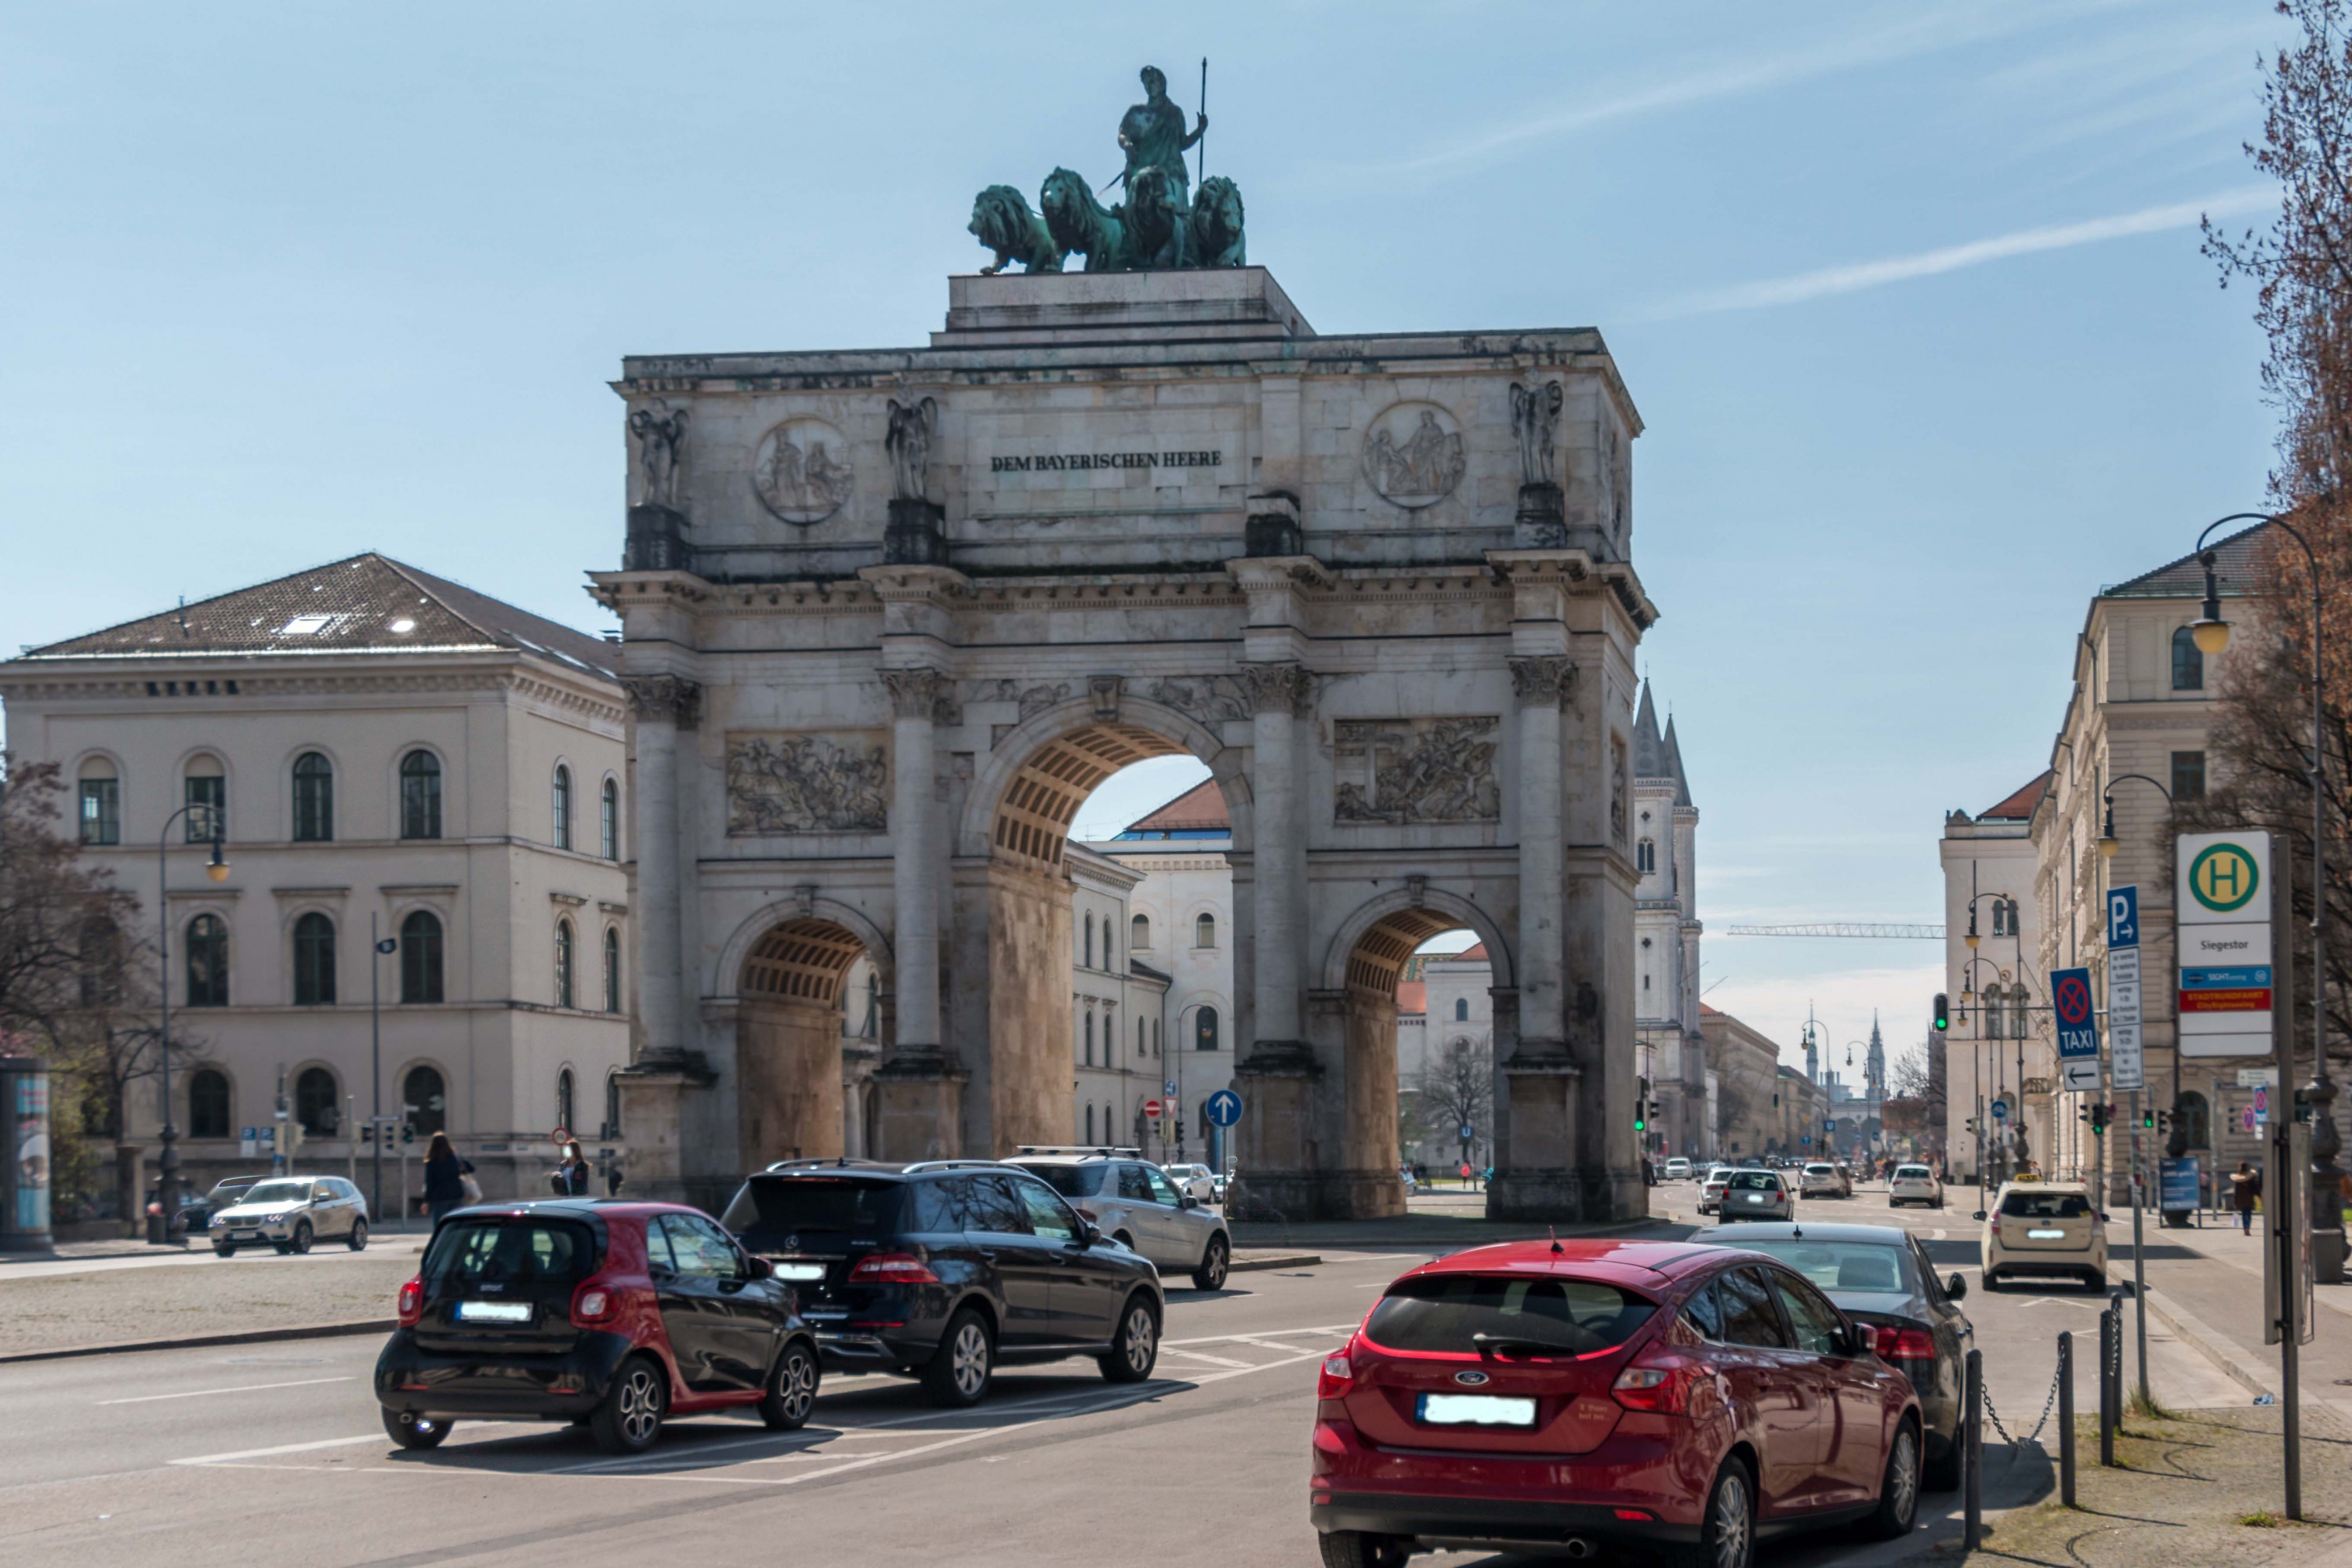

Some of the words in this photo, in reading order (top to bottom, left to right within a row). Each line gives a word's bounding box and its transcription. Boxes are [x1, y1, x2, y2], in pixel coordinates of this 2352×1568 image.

[990, 456, 1031, 472] DEM
[1034, 452, 1160, 470] BAYERISCHEN
[1162, 450, 1222, 467] HEERE
[2209, 858, 2238, 897] H
[2111, 895, 2129, 942] P
[2201, 940, 2249, 952] Siegestor
[2187, 991, 2264, 1001] STADTRUNDFAHRT
[2060, 1029, 2094, 1051] TAXI
[1461, 1127, 1471, 1137] U
